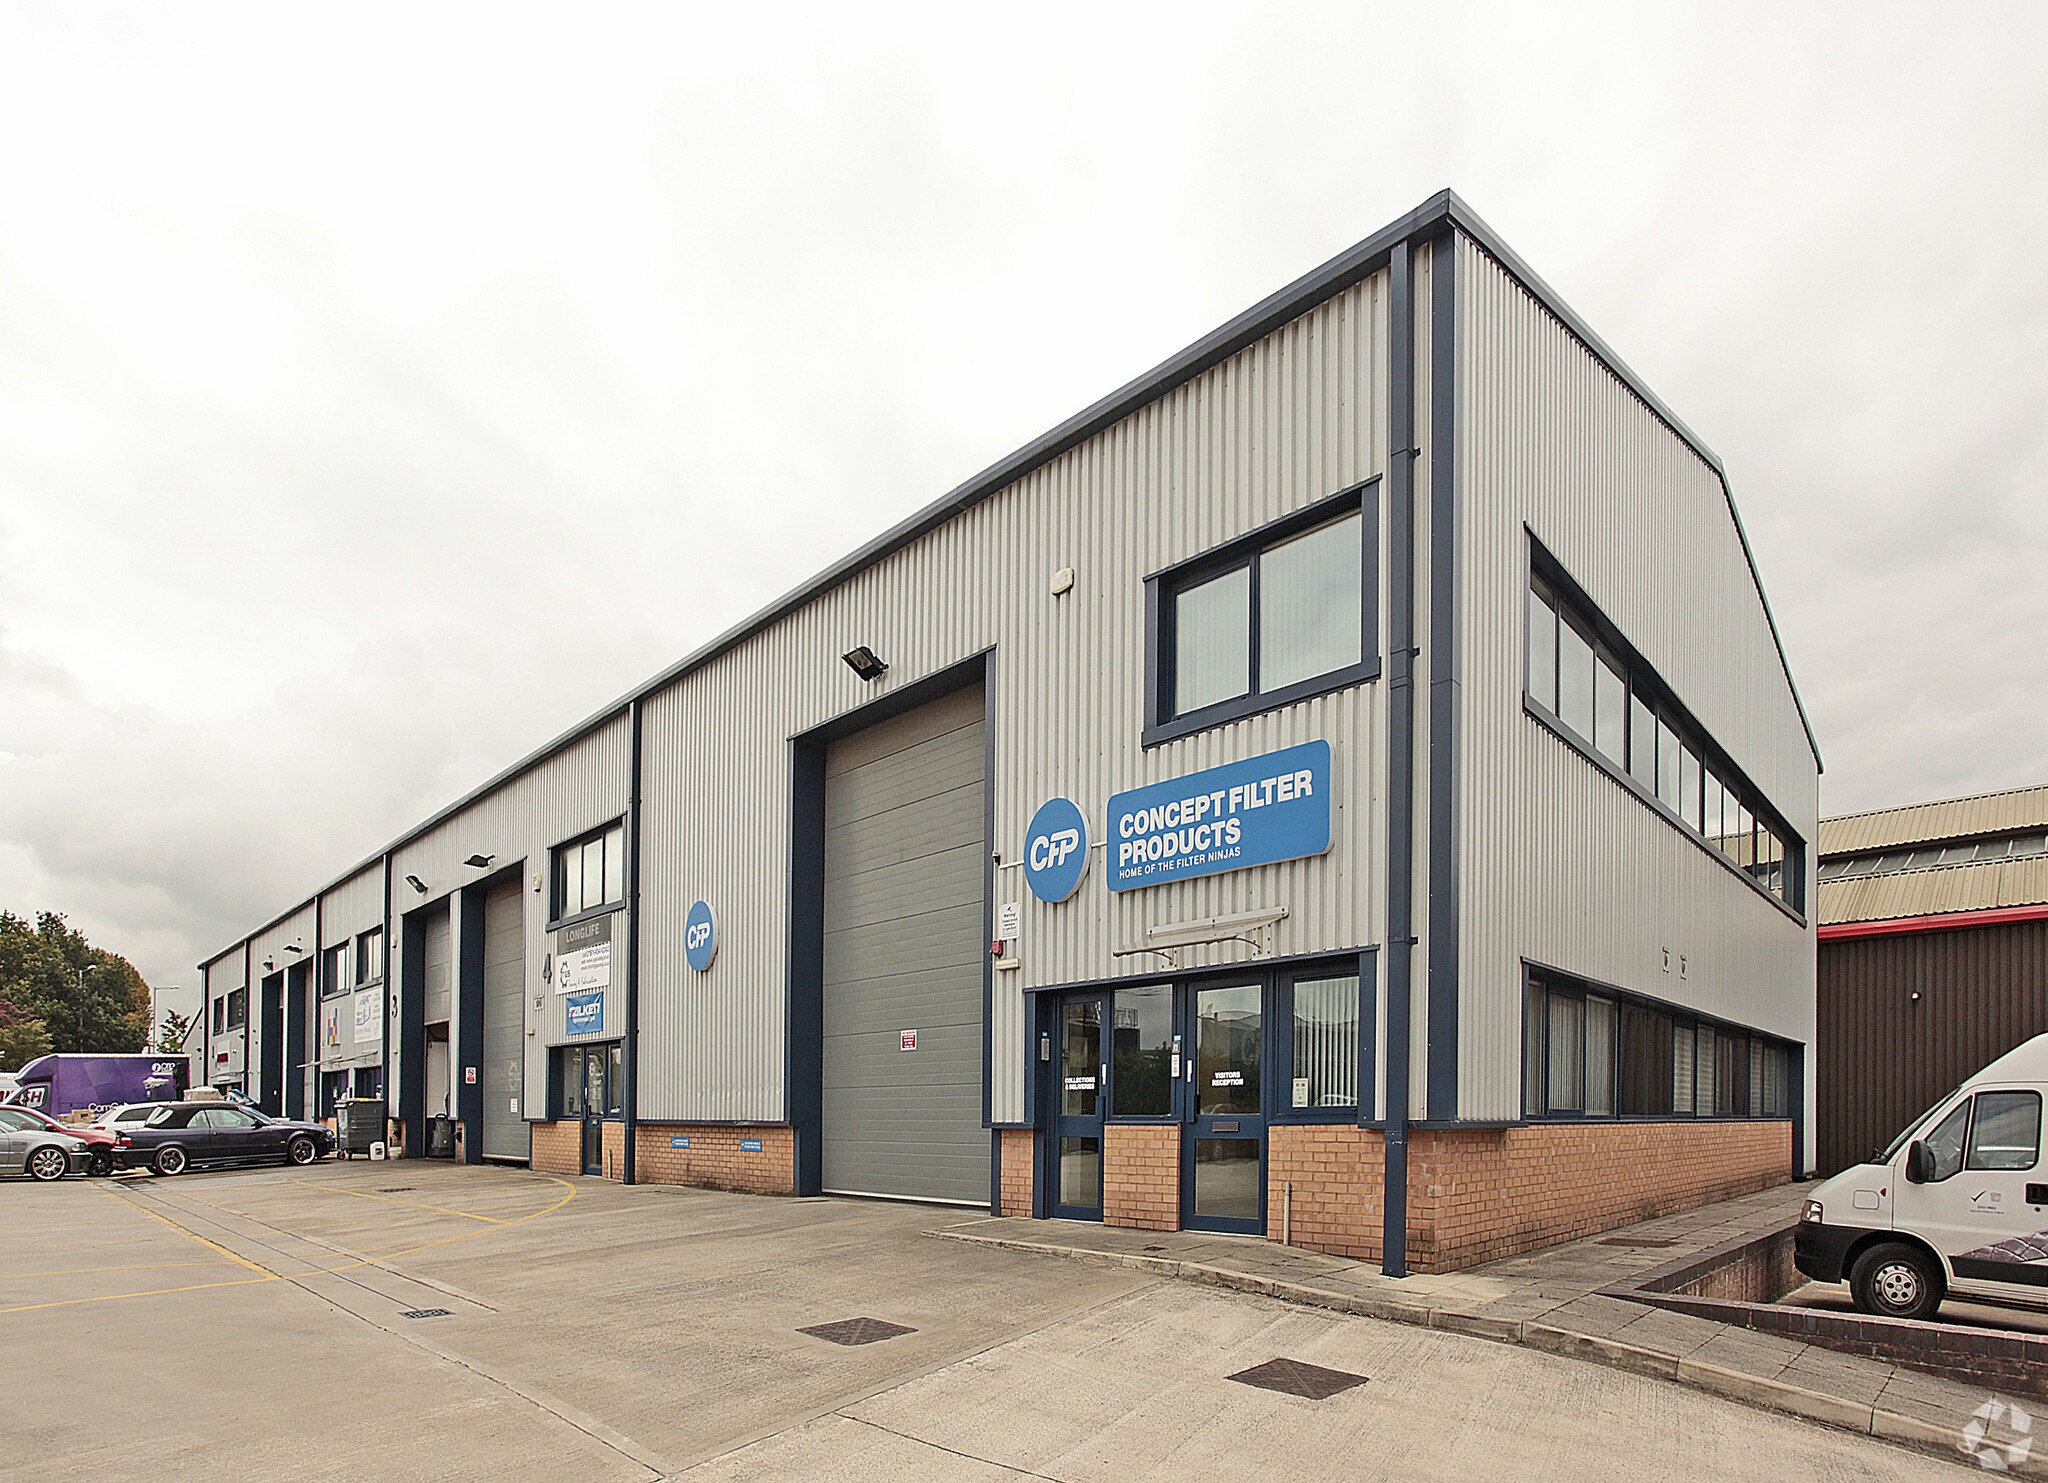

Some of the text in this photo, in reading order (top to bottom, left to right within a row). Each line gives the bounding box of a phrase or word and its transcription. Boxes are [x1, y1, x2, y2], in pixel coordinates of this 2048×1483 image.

[1119, 769, 1313, 838] CONCEPT FILTER
[1119, 818, 1242, 867] PRODUCTS
[1119, 846, 1241, 879] HOME OF THE FILTER NINJAS
[565, 923, 600, 943] LONGLIFE
[543, 953, 552, 984] 4
[392, 995, 398, 1018] 3
[568, 1002, 600, 1018] FALKEN
[1064, 1076, 1096, 1084] COLLECTIONS
[1211, 1078, 1244, 1087] RECEPTION
[1214, 1071, 1241, 1079] VISITORS
